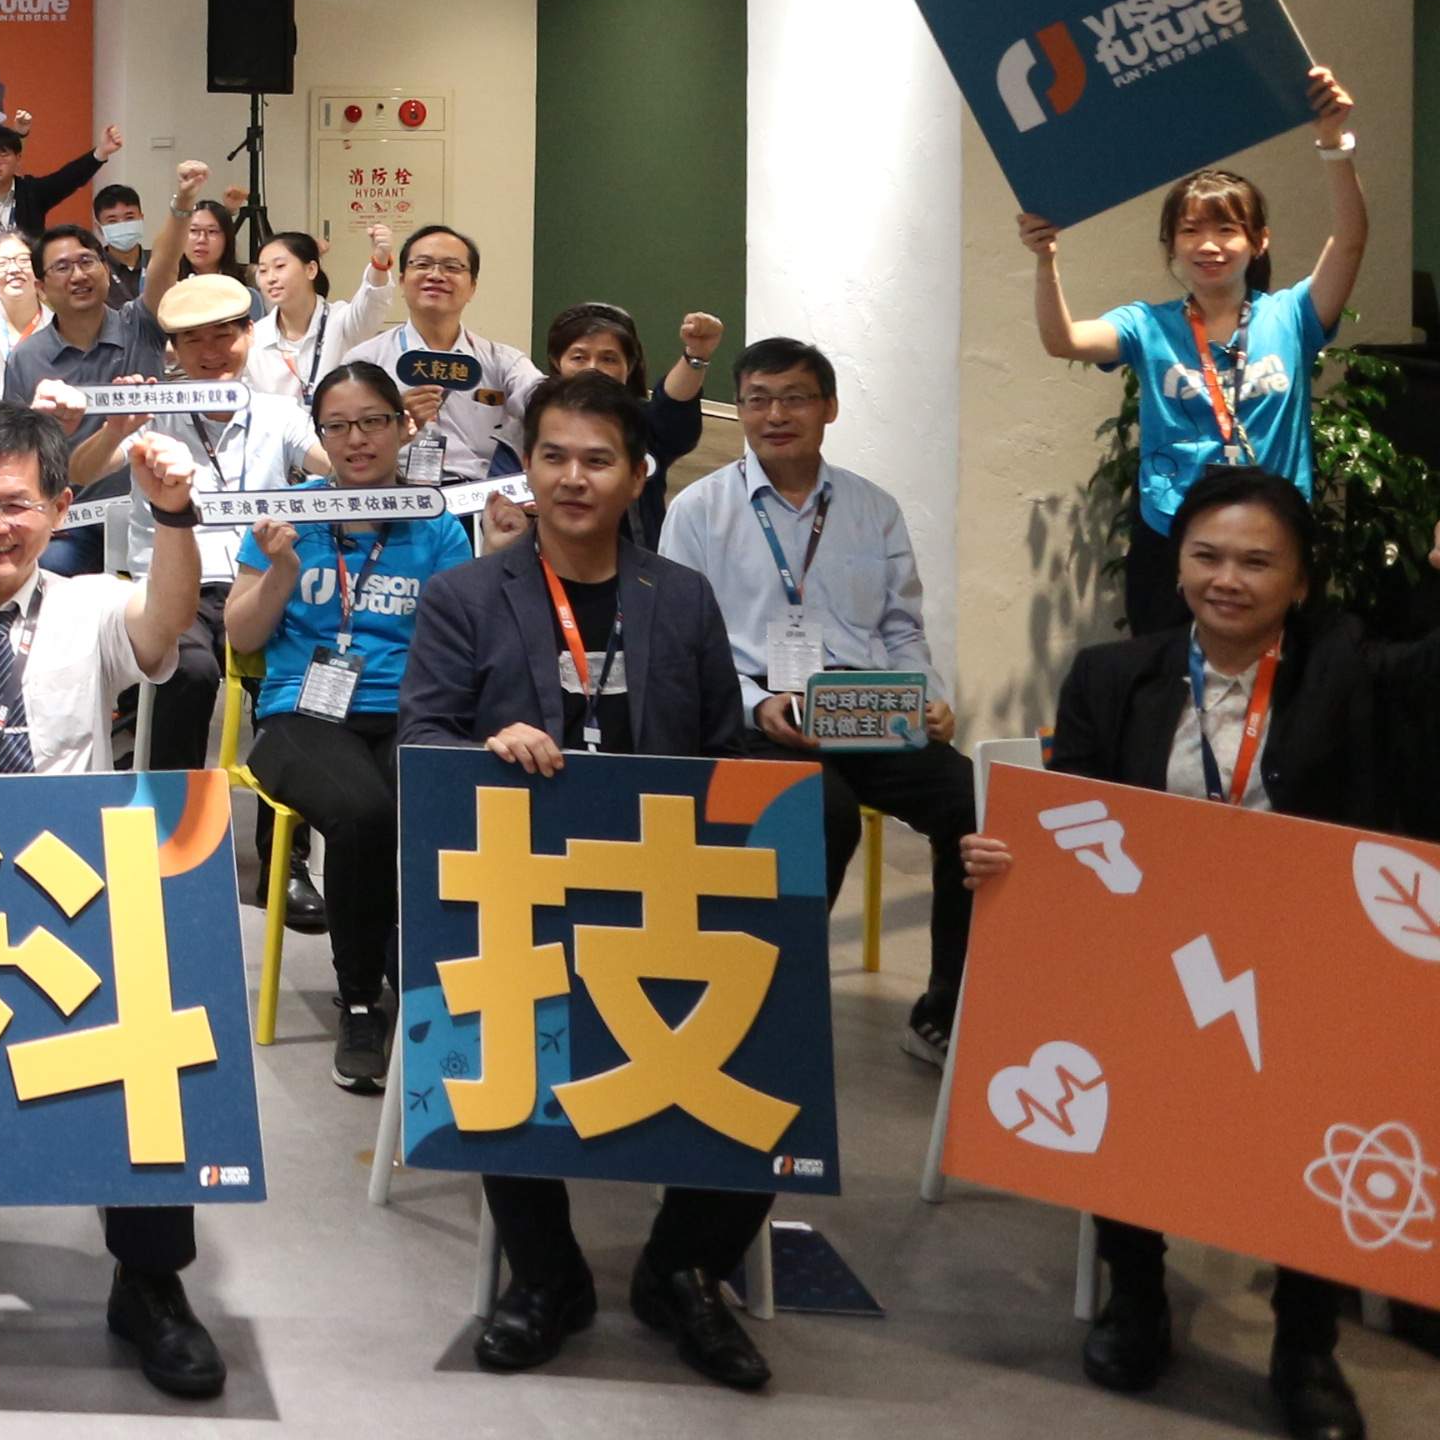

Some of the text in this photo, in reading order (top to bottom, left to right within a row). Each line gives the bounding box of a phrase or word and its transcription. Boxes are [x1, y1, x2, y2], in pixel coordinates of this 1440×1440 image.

[348, 168, 413, 186] 消防栓
[355, 188, 406, 198] HYDRANT
[341, 591, 417, 616] uture
[817, 690, 918, 710] 地球的未來
[435, 785, 801, 1153] 技
